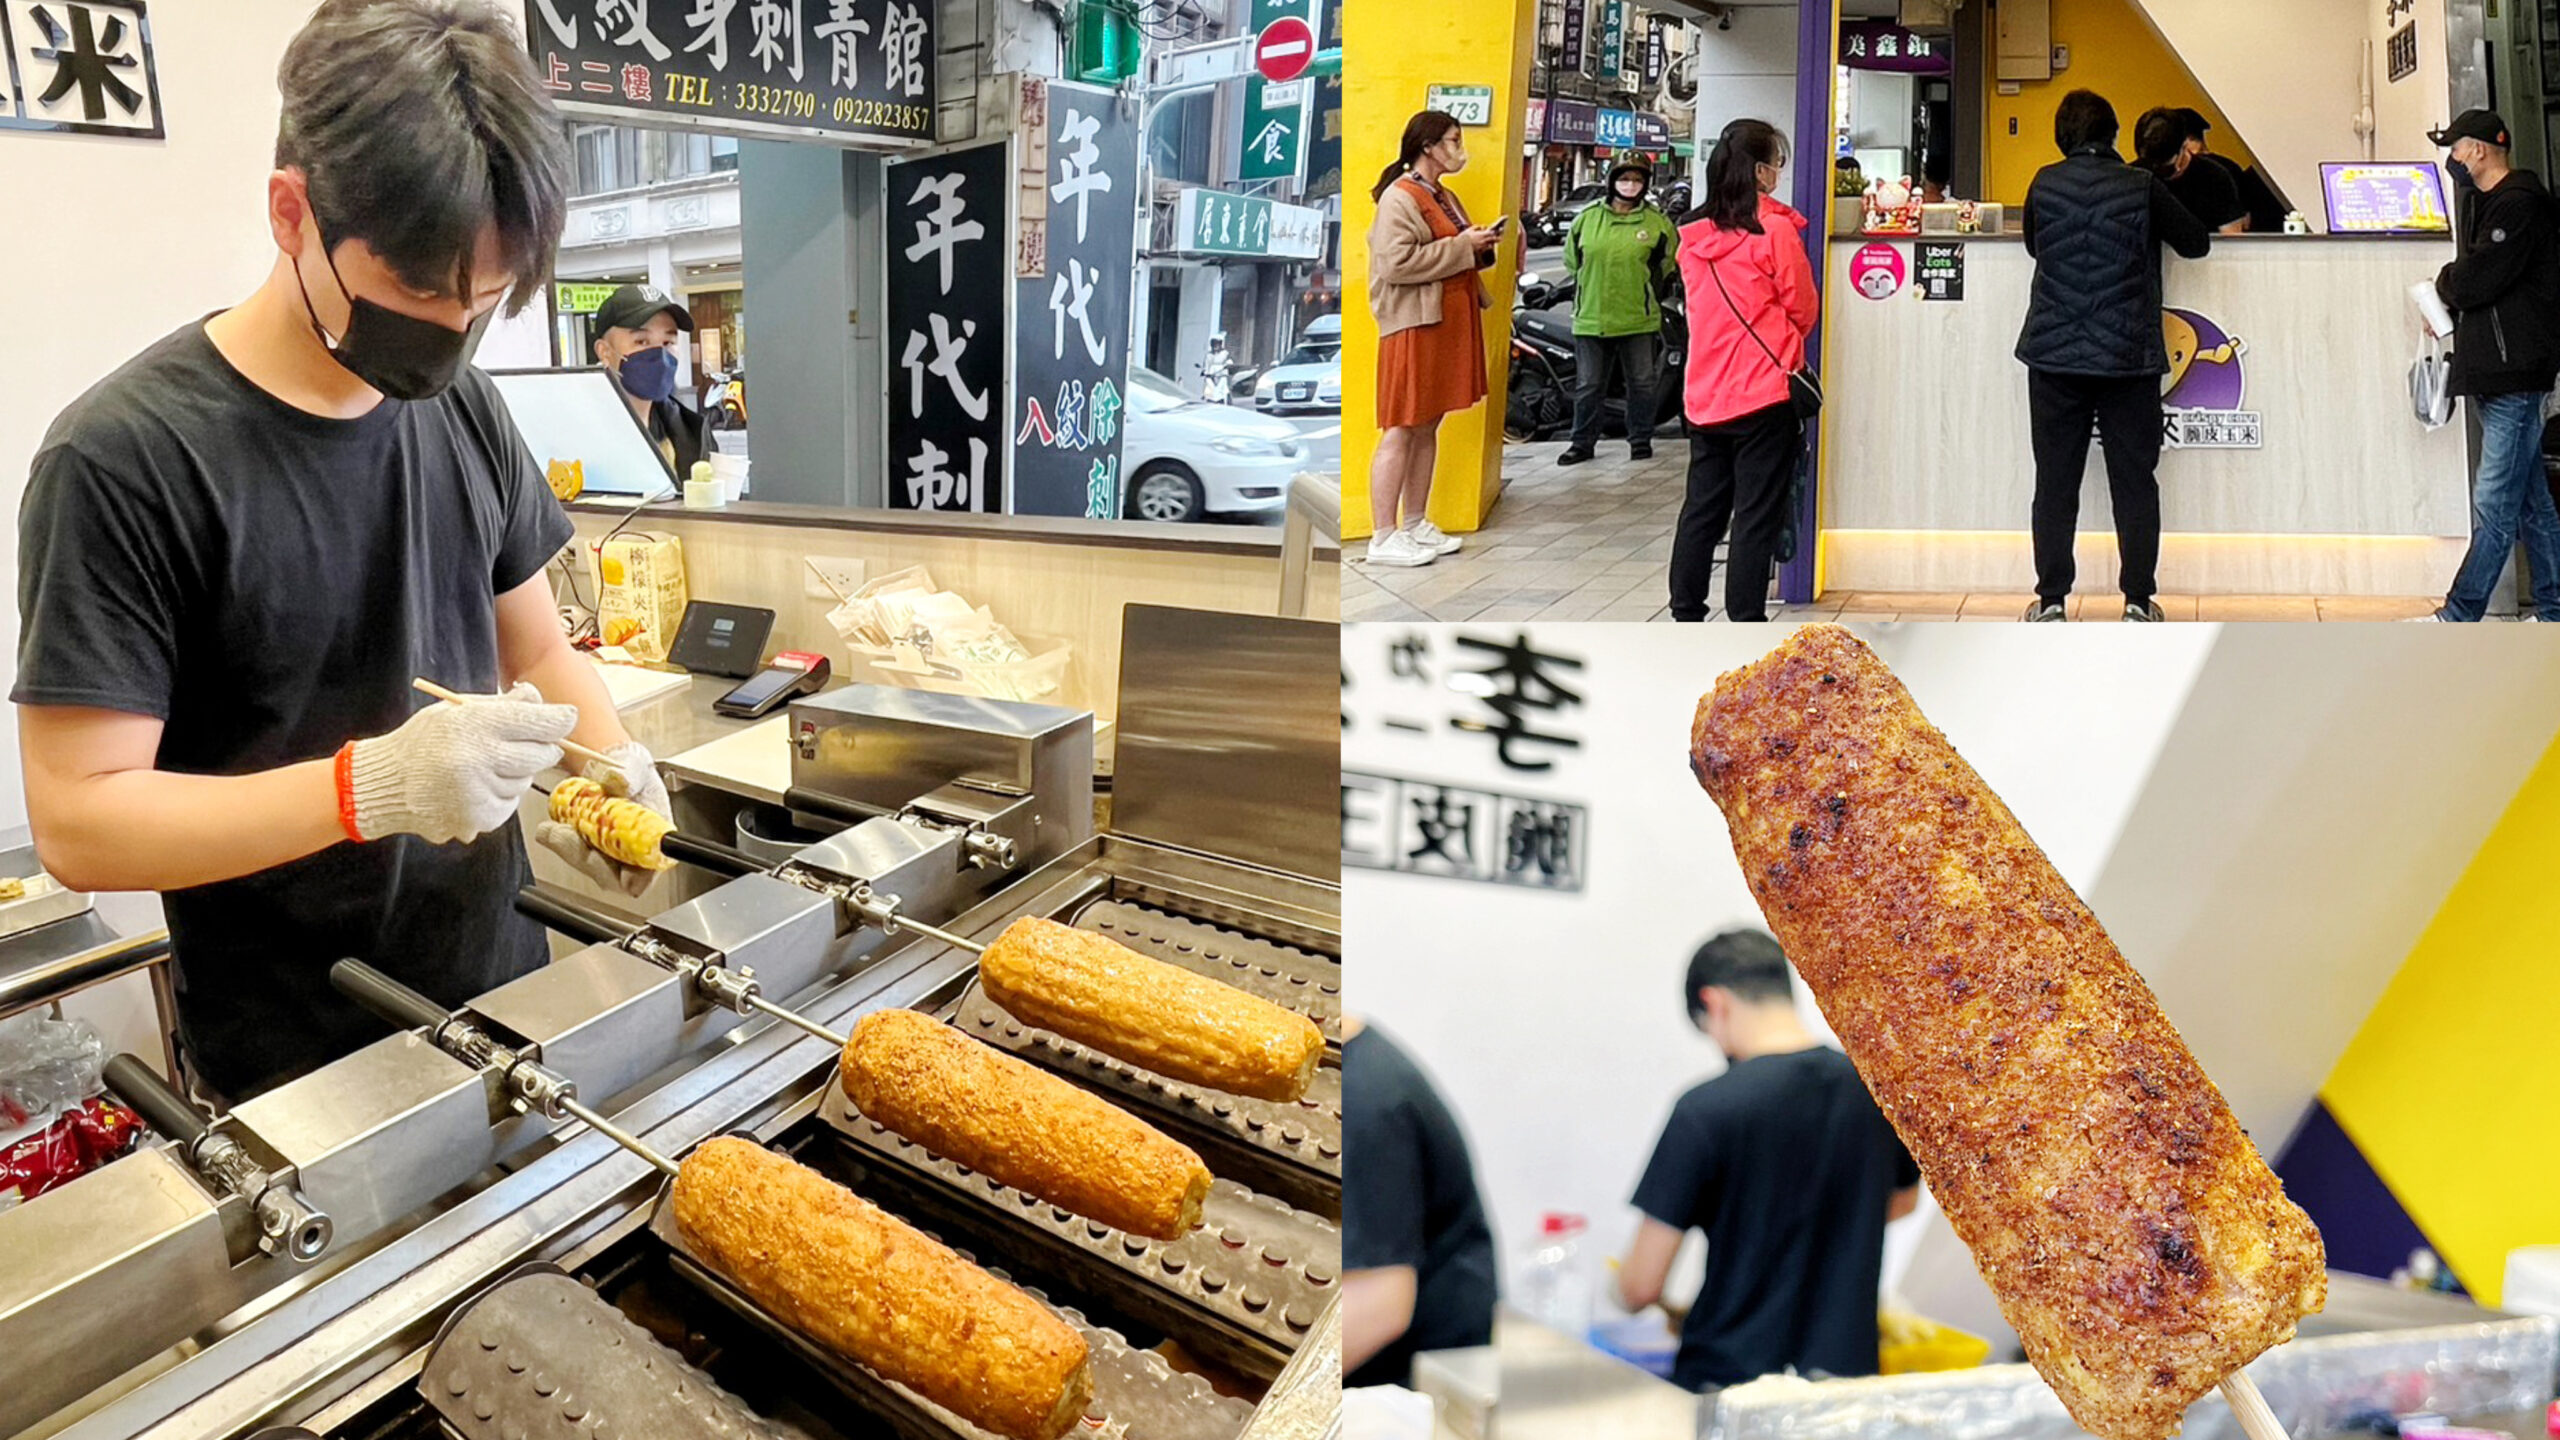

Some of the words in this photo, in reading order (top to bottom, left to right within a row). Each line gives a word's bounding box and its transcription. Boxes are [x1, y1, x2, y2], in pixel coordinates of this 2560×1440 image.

[1603, 0, 1619, 69] 馬銀樓
[29, 4, 143, 120] 米
[734, 83, 815, 117] 3332790
[833, 97, 929, 131] 0922823857
[1446, 103, 1480, 120] 173
[1248, 119, 1292, 164] 食
[1050, 109, 1111, 366] 年代
[1926, 246, 1952, 257] Uber
[1926, 258, 1952, 267] Eats
